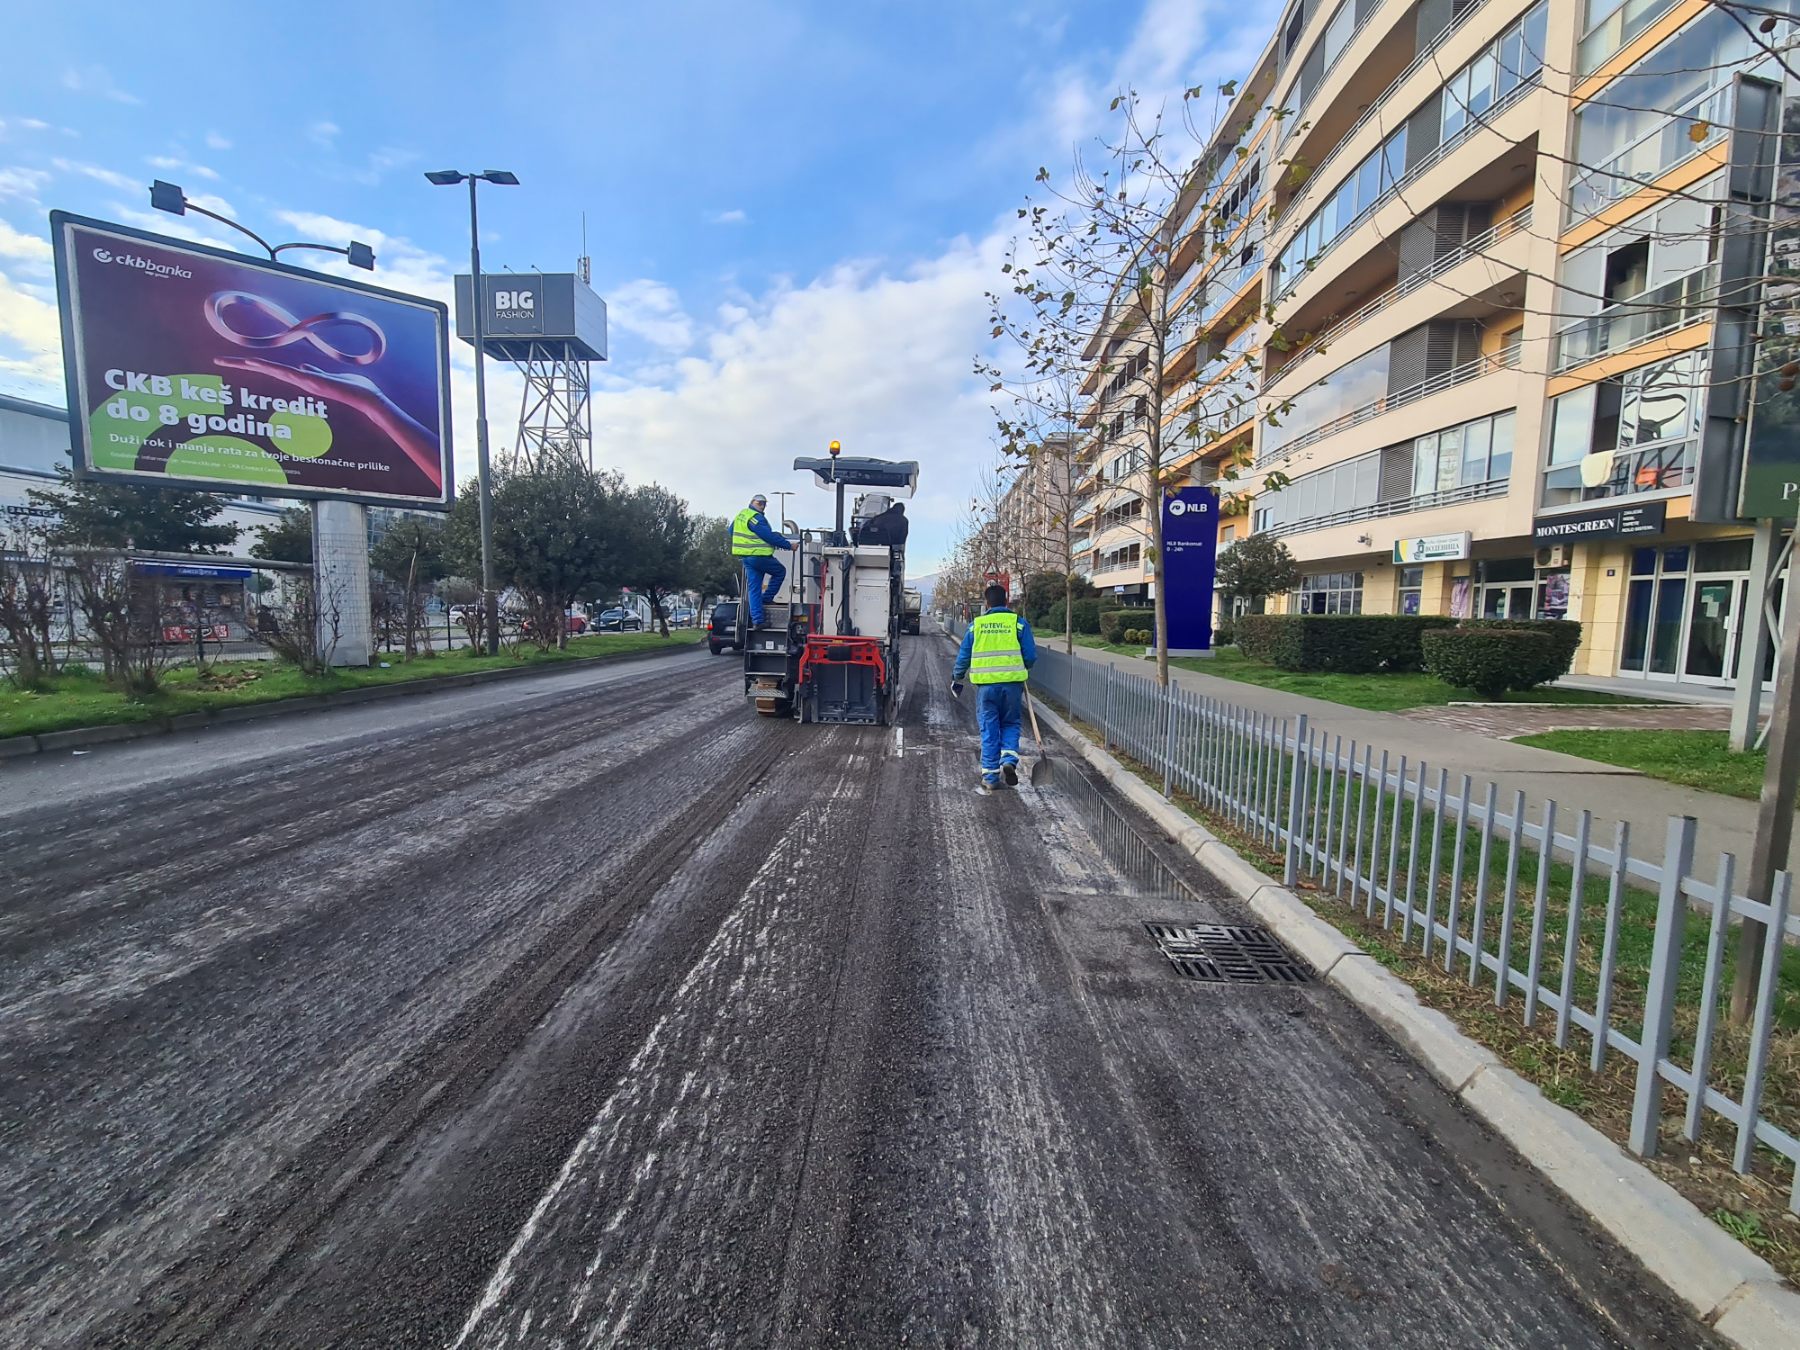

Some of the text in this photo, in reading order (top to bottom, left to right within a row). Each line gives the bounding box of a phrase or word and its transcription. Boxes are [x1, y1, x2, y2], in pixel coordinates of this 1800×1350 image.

[116, 255, 192, 278] ckbbanka
[495, 291, 534, 310] BIG
[496, 311, 534, 319] FASHION
[104, 369, 328, 419] CKB keš kredit
[106, 398, 292, 439] do 8 godina
[109, 433, 391, 472] Duži rok i manja rata za tvoje beskonačne prilike
[1781, 482, 1800, 500] P
[1187, 503, 1207, 512] NLB
[1536, 518, 1615, 537] MONTESCREEN
